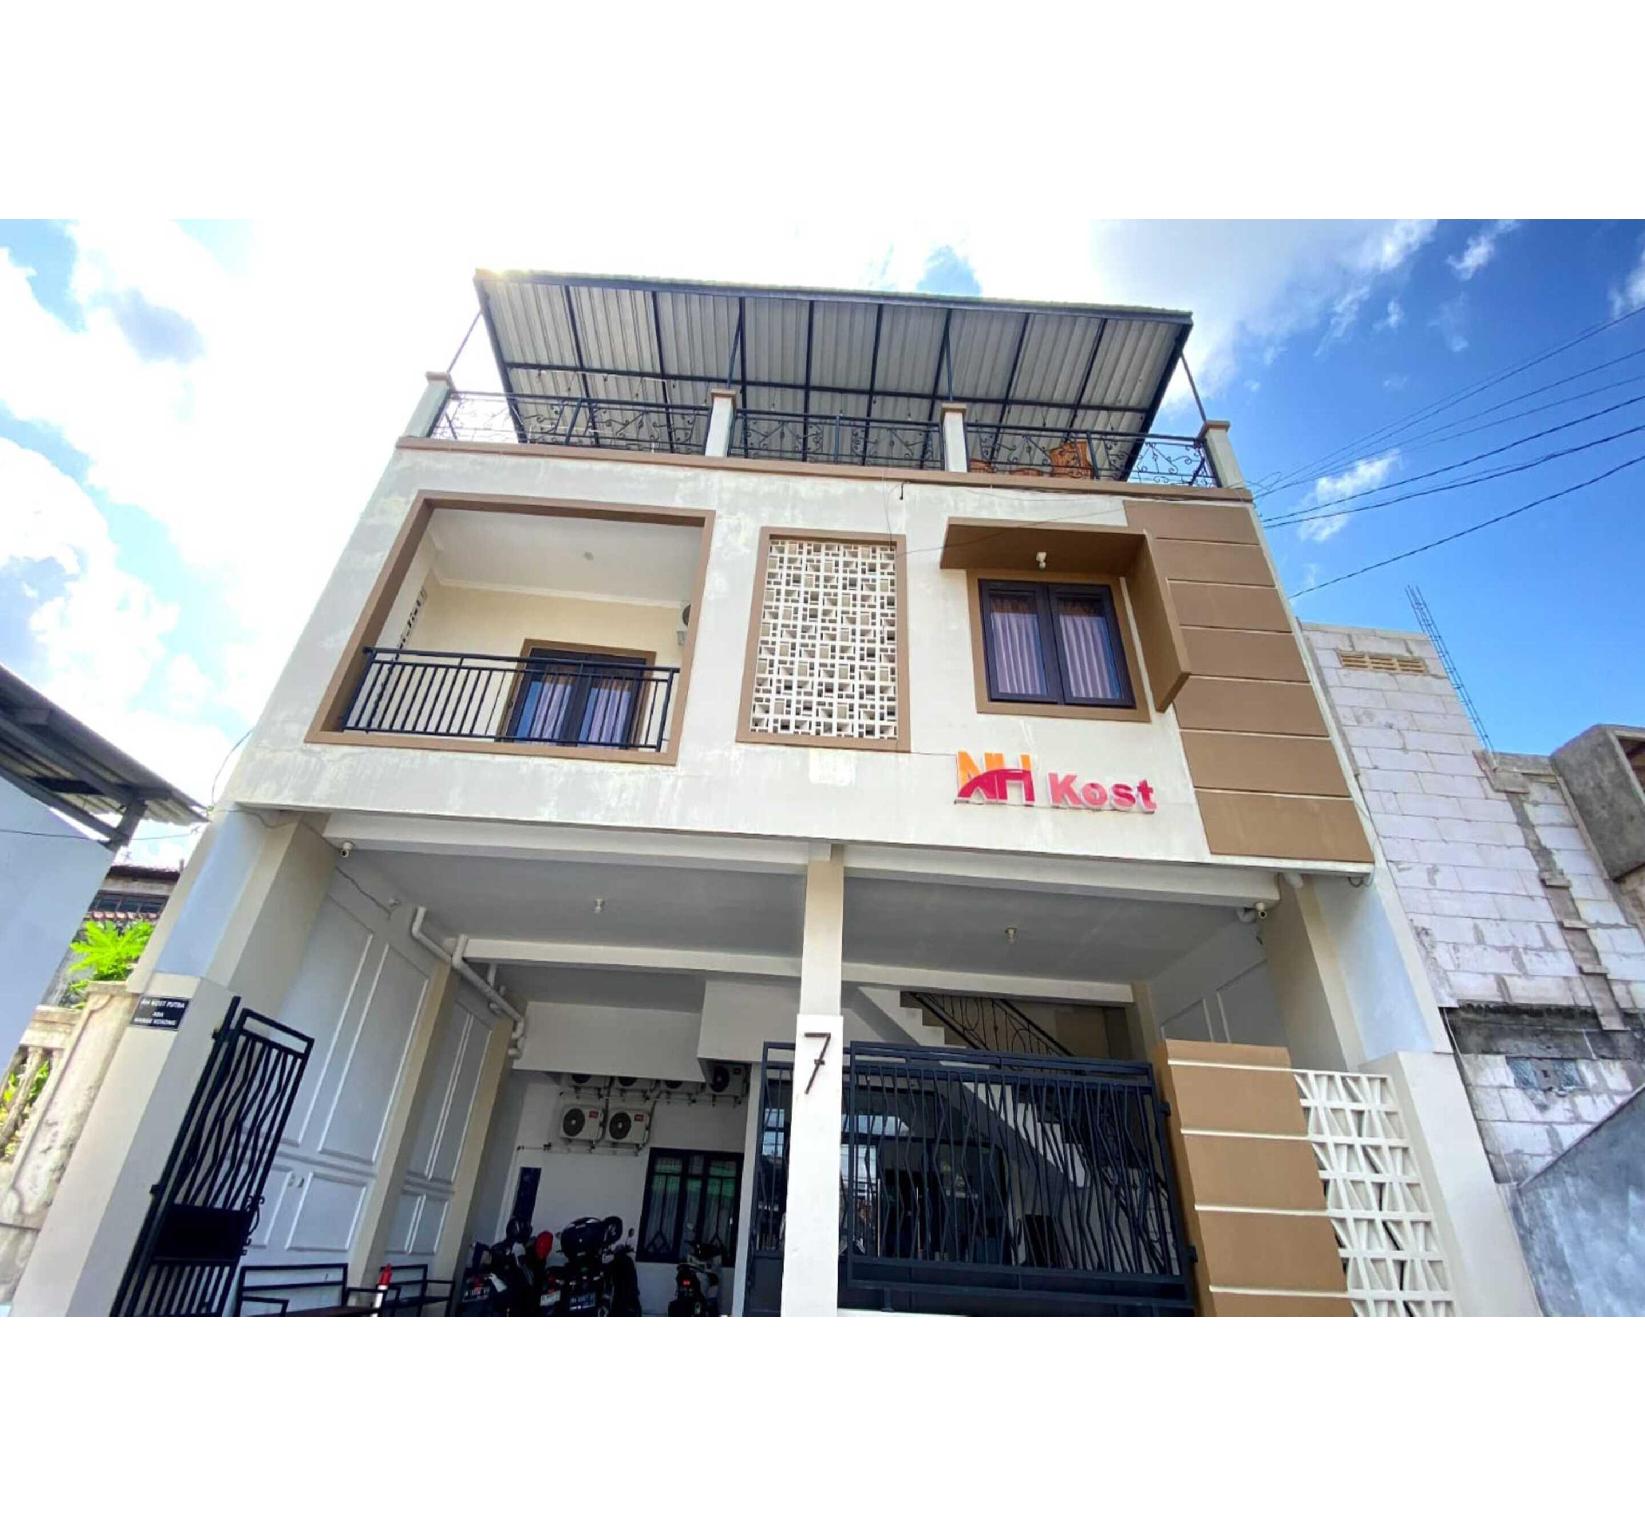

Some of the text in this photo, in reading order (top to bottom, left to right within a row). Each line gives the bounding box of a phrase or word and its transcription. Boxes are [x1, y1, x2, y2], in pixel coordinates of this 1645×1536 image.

[956, 750, 1157, 812] NH Kost
[804, 1032, 832, 1095] 7
